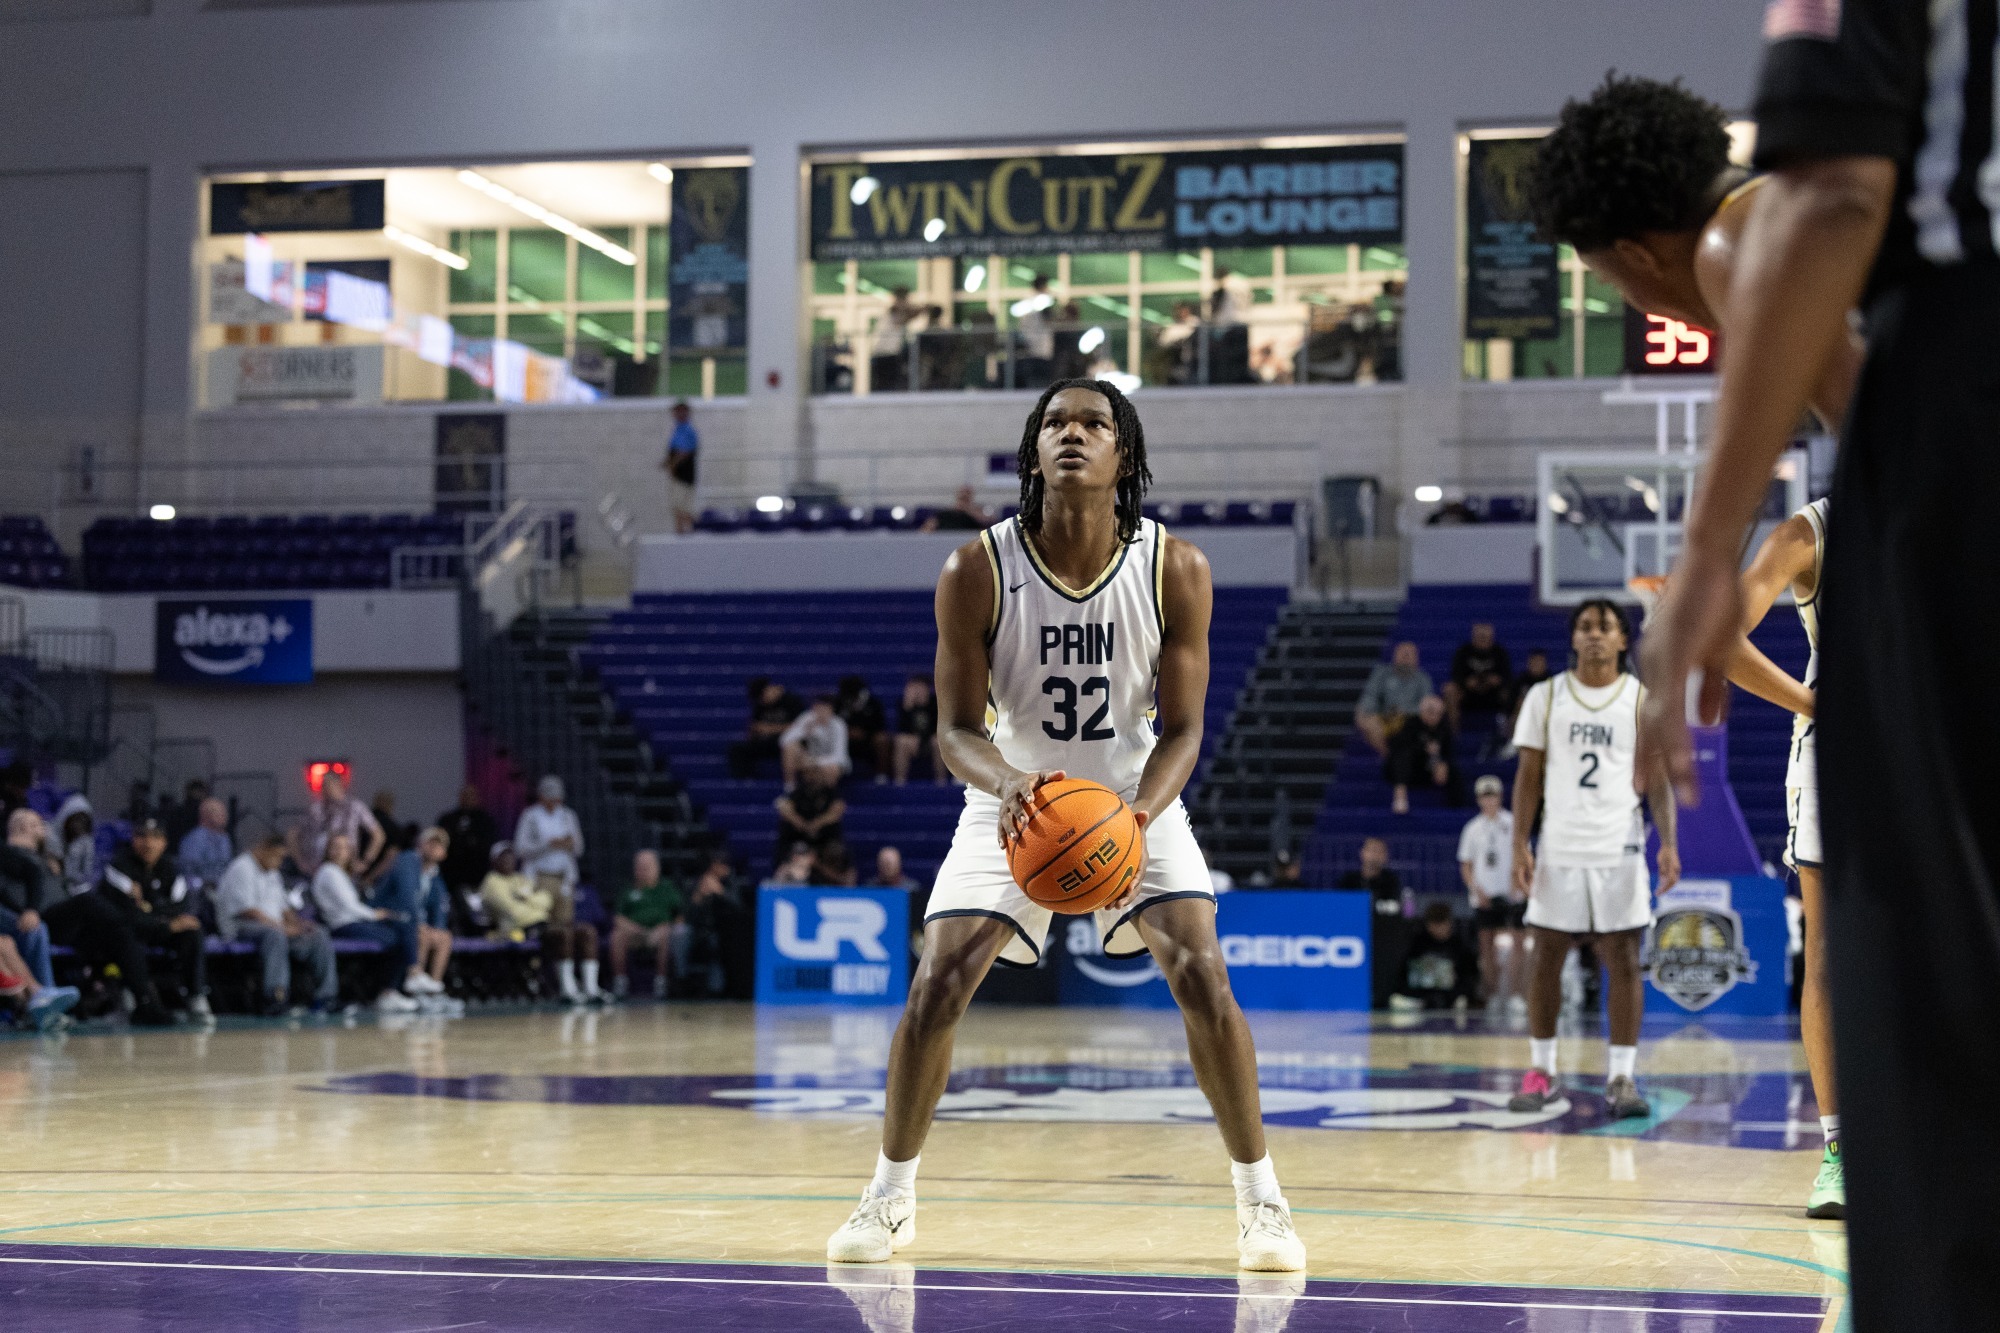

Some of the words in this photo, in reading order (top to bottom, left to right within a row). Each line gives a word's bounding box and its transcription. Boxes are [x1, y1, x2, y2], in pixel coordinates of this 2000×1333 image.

[1175, 160, 1399, 200] BARBER
[1175, 197, 1398, 237] LOUNGE
[1645, 313, 1711, 365] 35
[174, 606, 293, 646] alexa+
[1040, 622, 1114, 666] PRIN
[1042, 676, 1116, 742] 32
[1569, 722, 1613, 747] PRIN
[1579, 753, 1601, 789] 2
[1056, 837, 1120, 893] ELITE
[1220, 934, 1366, 968] GEICO
